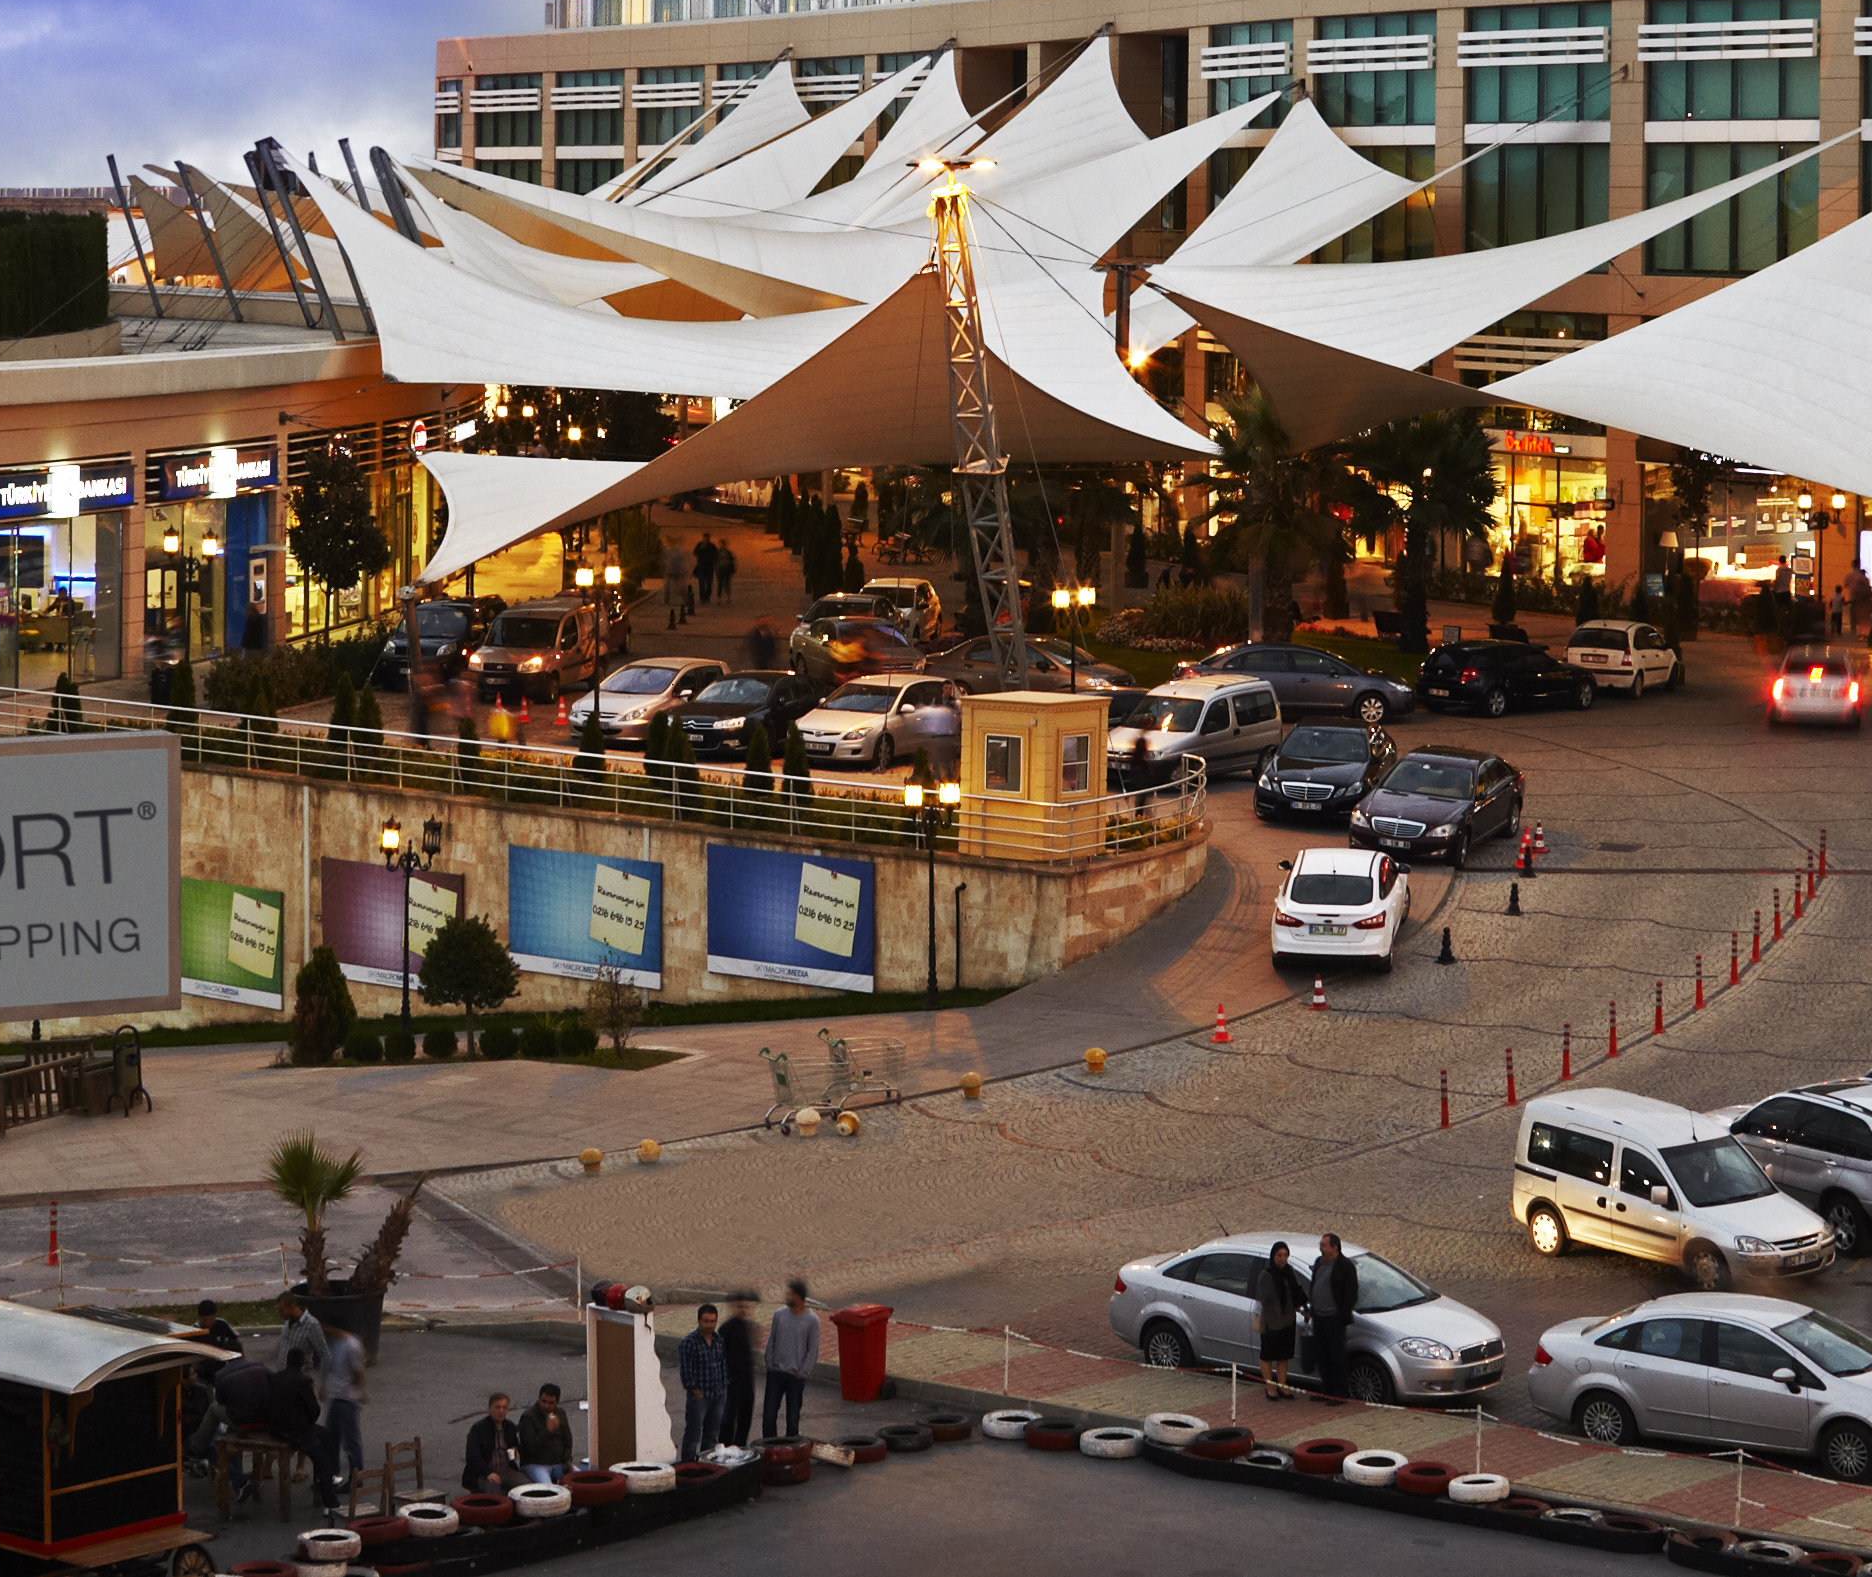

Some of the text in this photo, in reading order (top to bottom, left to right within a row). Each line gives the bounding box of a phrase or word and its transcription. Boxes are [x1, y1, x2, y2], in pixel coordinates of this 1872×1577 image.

[176, 464, 212, 488] TÜRKİY
[409, 917, 420, 929] 216
[798, 905, 855, 931] 0216 696 15 25
